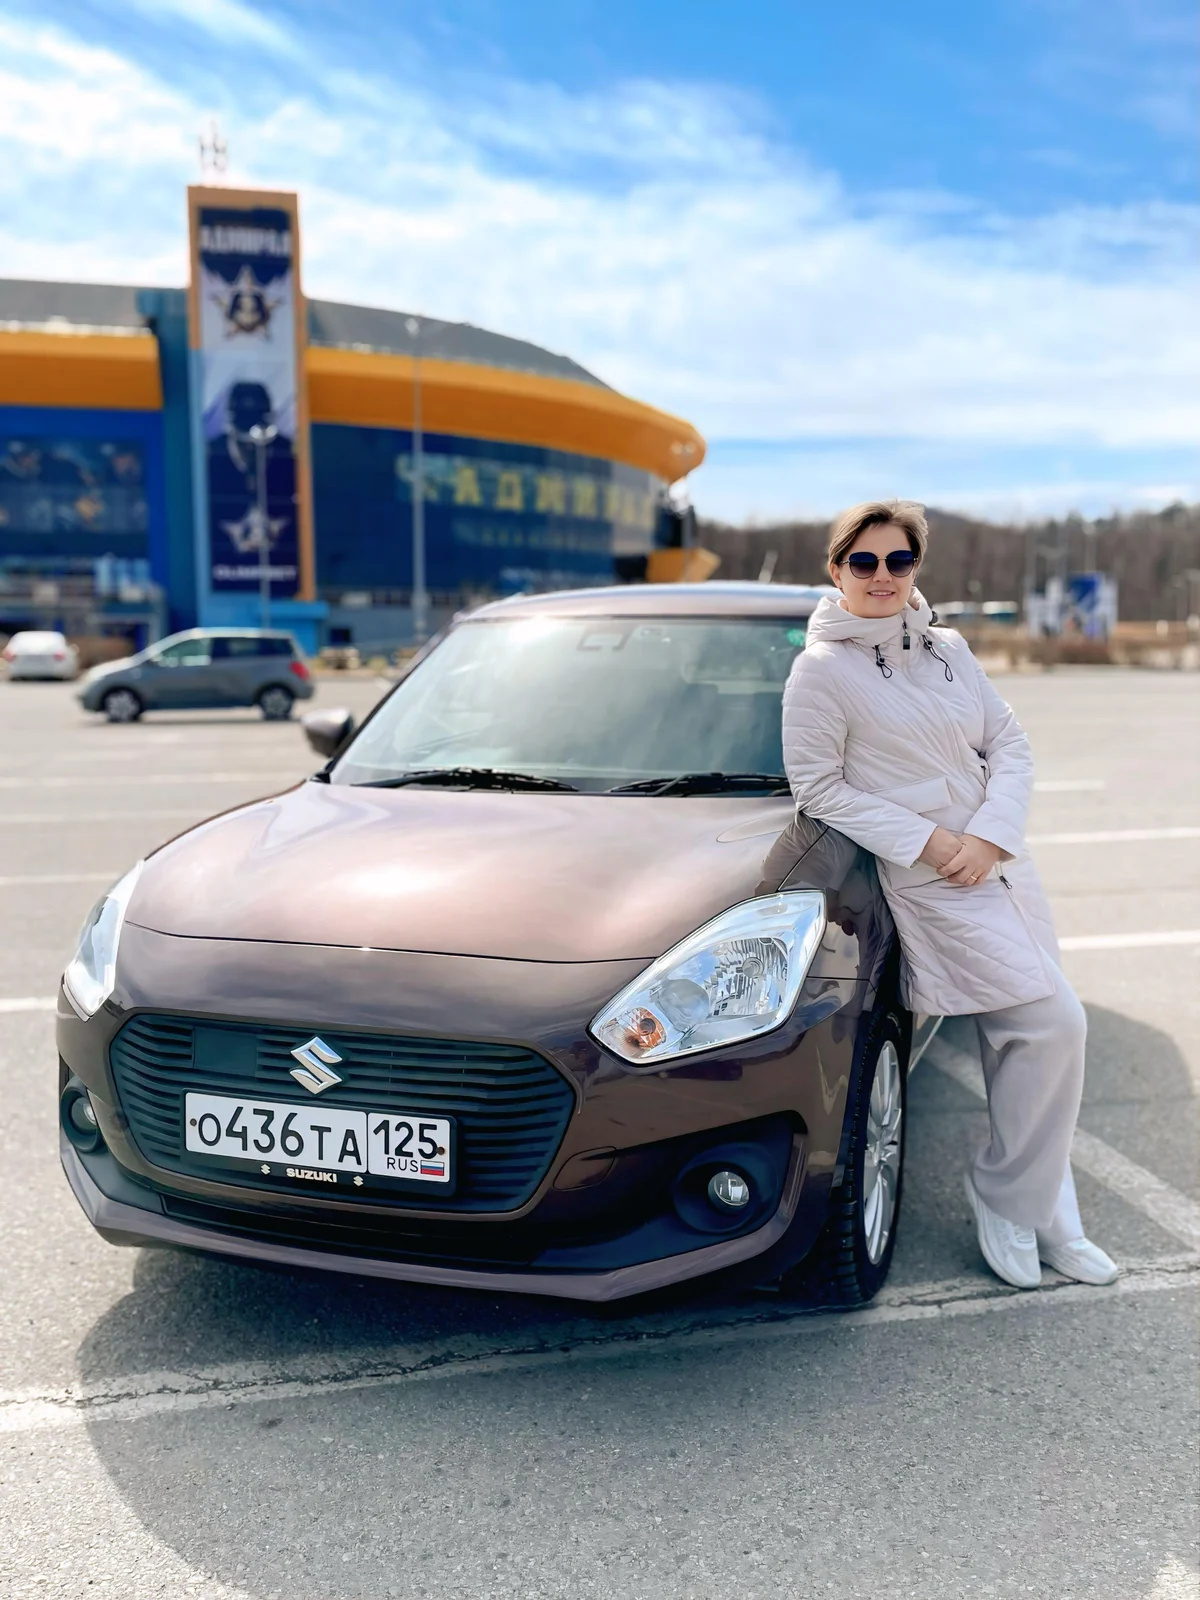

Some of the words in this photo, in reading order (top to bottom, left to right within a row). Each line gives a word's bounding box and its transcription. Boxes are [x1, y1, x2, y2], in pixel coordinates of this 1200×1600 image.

[372, 1119, 439, 1160] 125
[386, 1156, 419, 1173] RUS
[286, 1167, 338, 1184] SUZUKI
